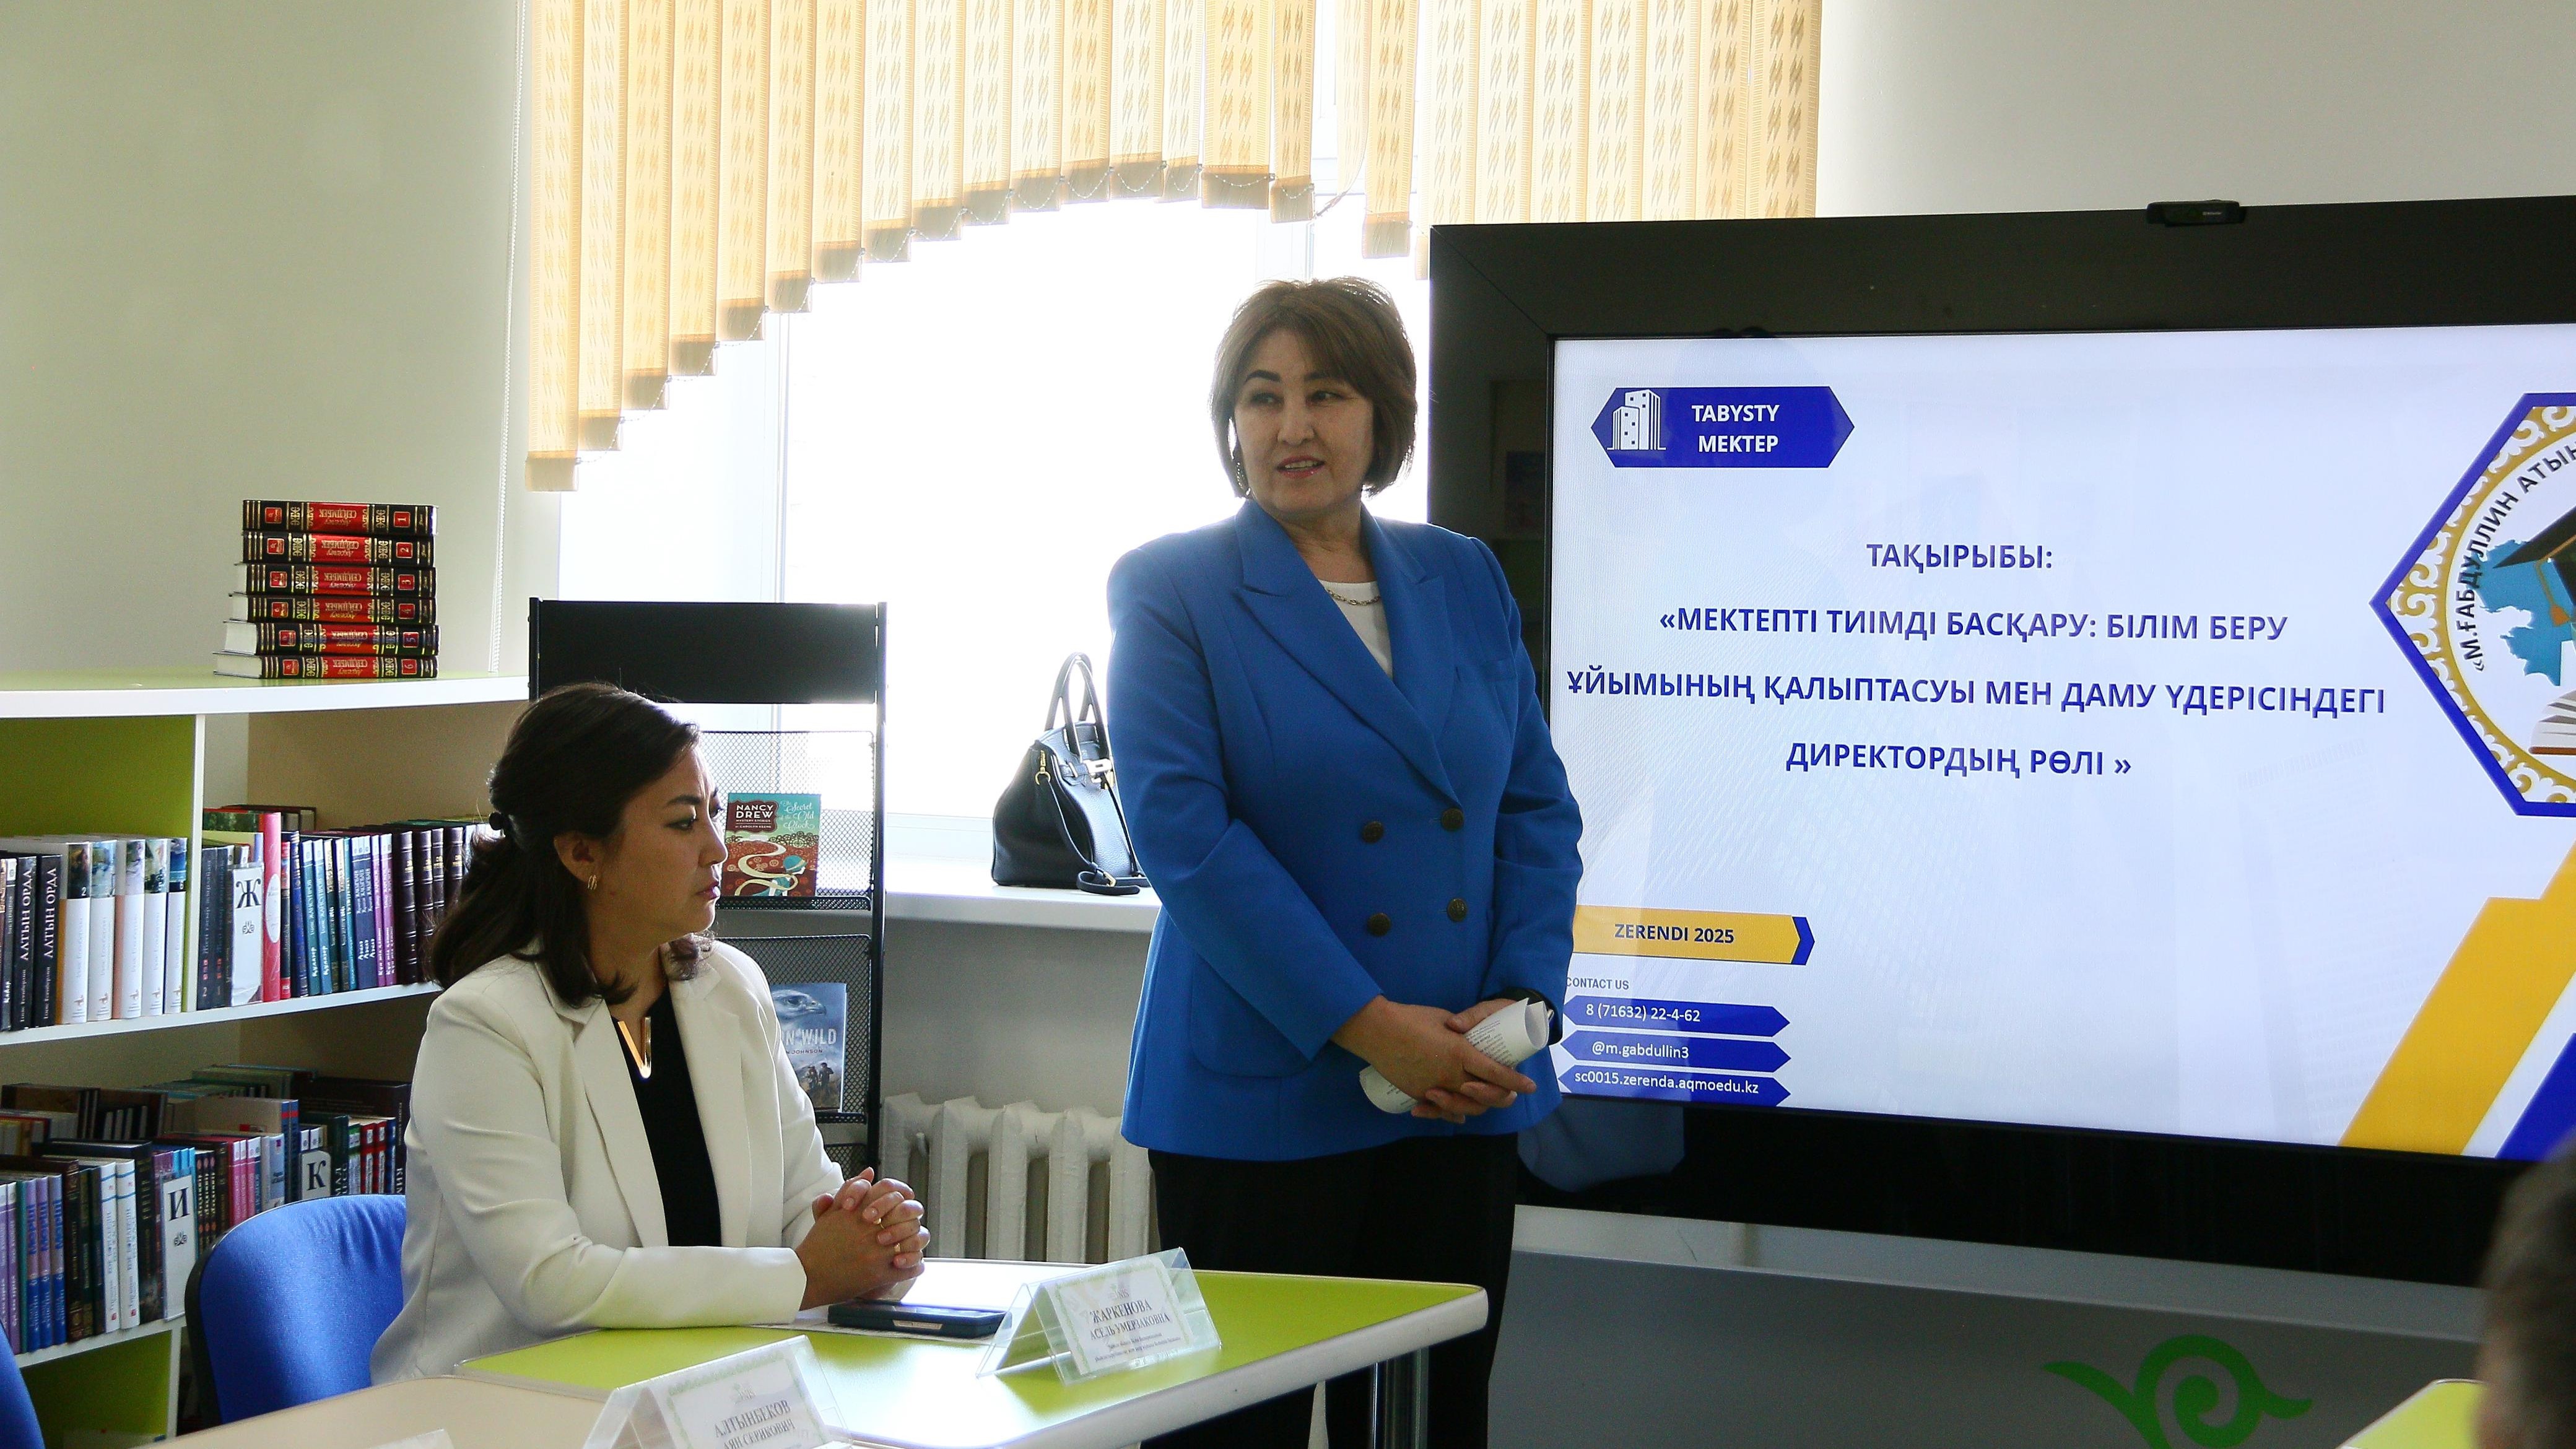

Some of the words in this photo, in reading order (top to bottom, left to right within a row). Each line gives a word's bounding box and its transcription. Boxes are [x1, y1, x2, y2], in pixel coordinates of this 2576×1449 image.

[1692, 404, 1780, 422] TABYSTY
[1699, 435, 1778, 453] MEKTEP
[1866, 543, 2053, 573] ТАҚЫРЫБЫ:
[1660, 607, 1817, 632] «МЕКТЕПТІ
[1826, 610, 1936, 640] ТИІМДІ
[1947, 612, 2095, 642] БАСҚАРУ:
[2107, 614, 2198, 640] БІЛІМ
[2209, 615, 2288, 640] БЕРУ
[1567, 664, 1756, 704] ҰЙЫМЫНЫҢ
[1764, 676, 1974, 705] ҚАЛЫПТАСУЫ
[1985, 681, 2052, 705] МЕН
[2061, 682, 2156, 712] ДАМУ
[2165, 684, 2385, 719] ҮДЕРІСІНДЕГІ
[1786, 742, 2020, 778] ДИРЕКТОРДЫҢ
[2030, 749, 2104, 775] РӨЛІ
[22, 868, 32, 906] ОРДА
[46, 868, 58, 904] ОРДА
[235, 878, 261, 909] Ж
[19, 910, 31, 961] АЛТЫН
[43, 908, 55, 958] АЛТЫН
[1614, 923, 1689, 942] ZERENDI
[1694, 928, 1734, 944] 2025
[1567, 977, 1612, 990] CONTACT
[1615, 979, 1630, 990] US
[1586, 1004, 1594, 1016] 8
[1598, 1003, 1647, 1021] (71632)
[1651, 1007, 1701, 1022] 22-4-62
[801, 1028, 837, 1045] WILD
[1592, 1040, 1689, 1059] @m.gabdullin3
[1575, 1071, 1759, 1094] sc0015.zerenda.aqmoedu.kz
[307, 1160, 327, 1191] К
[168, 1186, 189, 1221] И
[1089, 1298, 1153, 1325] ЖАРКЕНОВА
[1090, 1323, 1115, 1341] АСЕЛЬ
[1114, 1312, 1170, 1336] УМЕРЗАКОВНА
[713, 1399, 791, 1438] АЛТЫНБЕКОВ
[742, 1417, 796, 1448] СЕРИКОВИЧ
